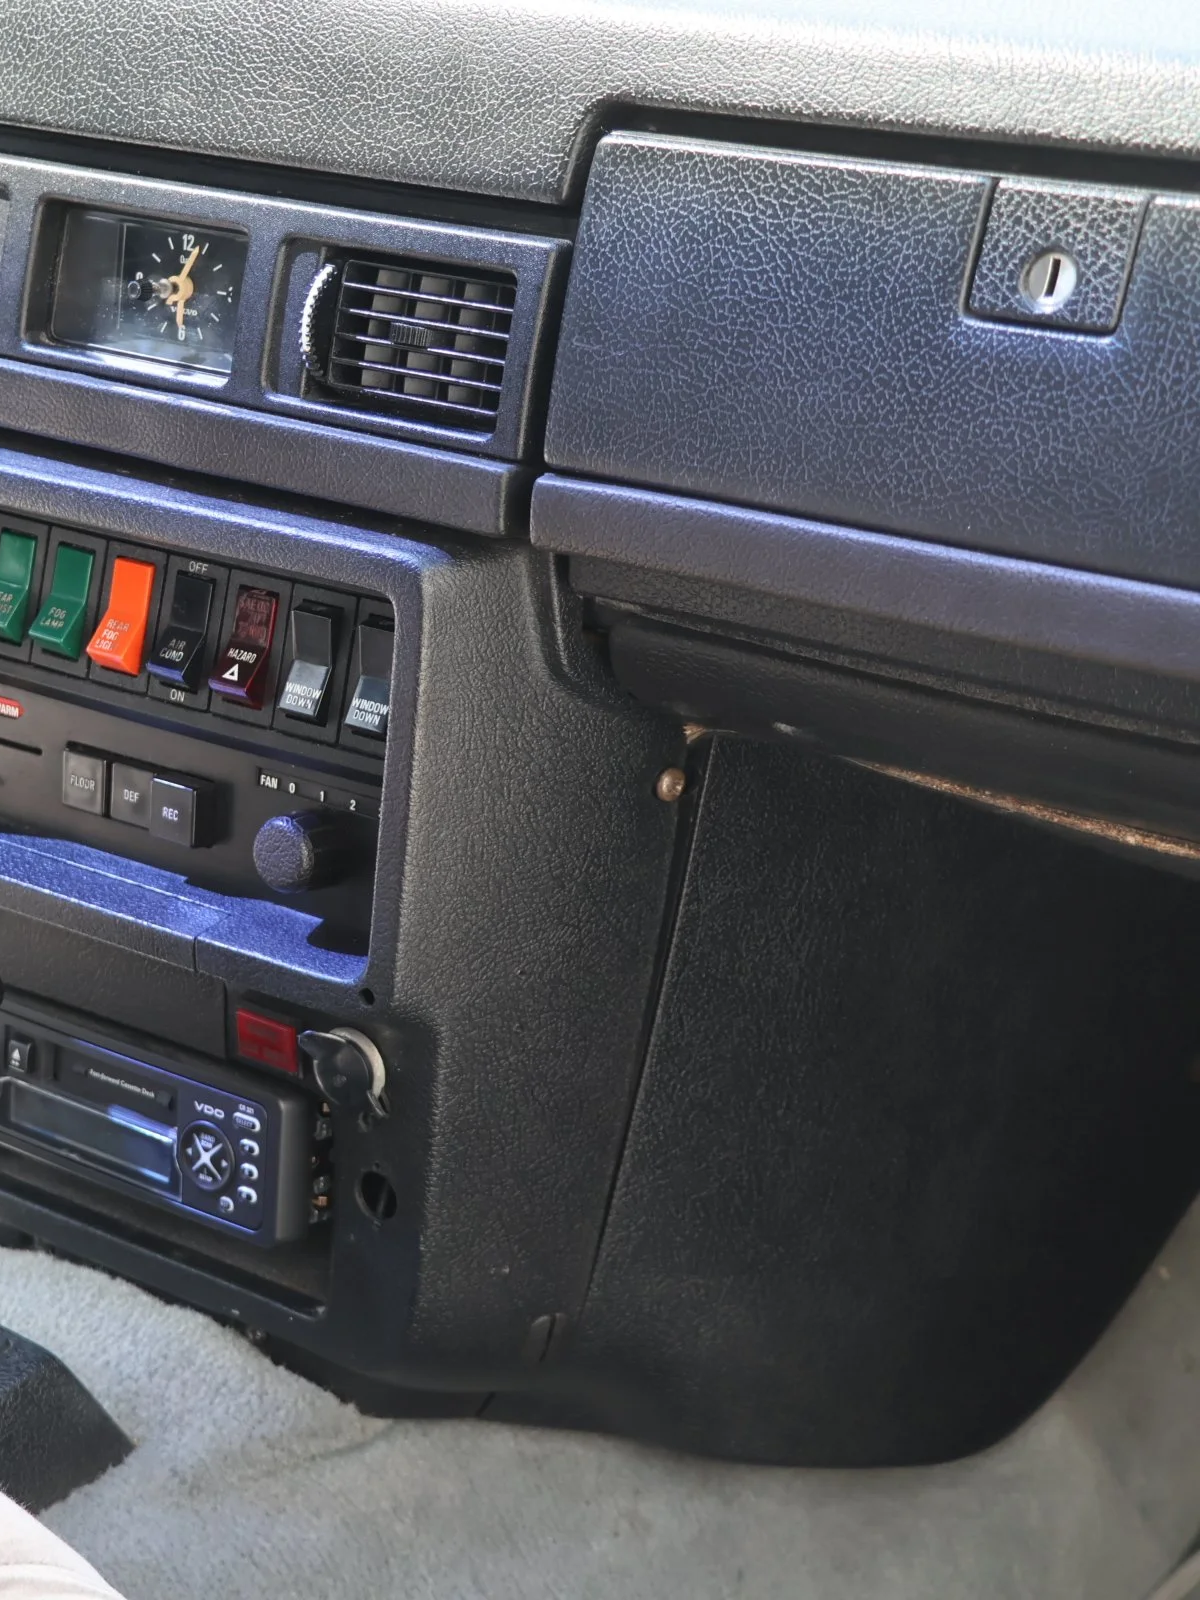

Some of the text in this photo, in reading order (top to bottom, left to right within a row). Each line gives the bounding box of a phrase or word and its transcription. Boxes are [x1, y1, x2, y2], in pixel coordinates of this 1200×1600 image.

[183, 234, 195, 251] 12
[178, 325, 186, 340] 6
[189, 560, 208, 574] OFF
[48, 607, 67, 618] FOG
[40, 617, 65, 628] LAMP
[107, 618, 130, 632] REAR
[169, 639, 186, 650] AIR
[160, 647, 184, 662] COND
[227, 648, 257, 664] HAZARD
[170, 689, 185, 702] ON
[286, 682, 322, 698] WINDOW
[286, 694, 313, 709] DOWN
[352, 697, 389, 715] WINDOW
[353, 710, 381, 726] DOWN
[70, 775, 95, 791] FLOOR
[123, 789, 140, 803] DEF
[260, 774, 278, 790] FAN
[289, 782, 296, 794] 0
[349, 799, 356, 811] 2
[162, 806, 179, 821] REC
[194, 1100, 225, 1120] VDO
